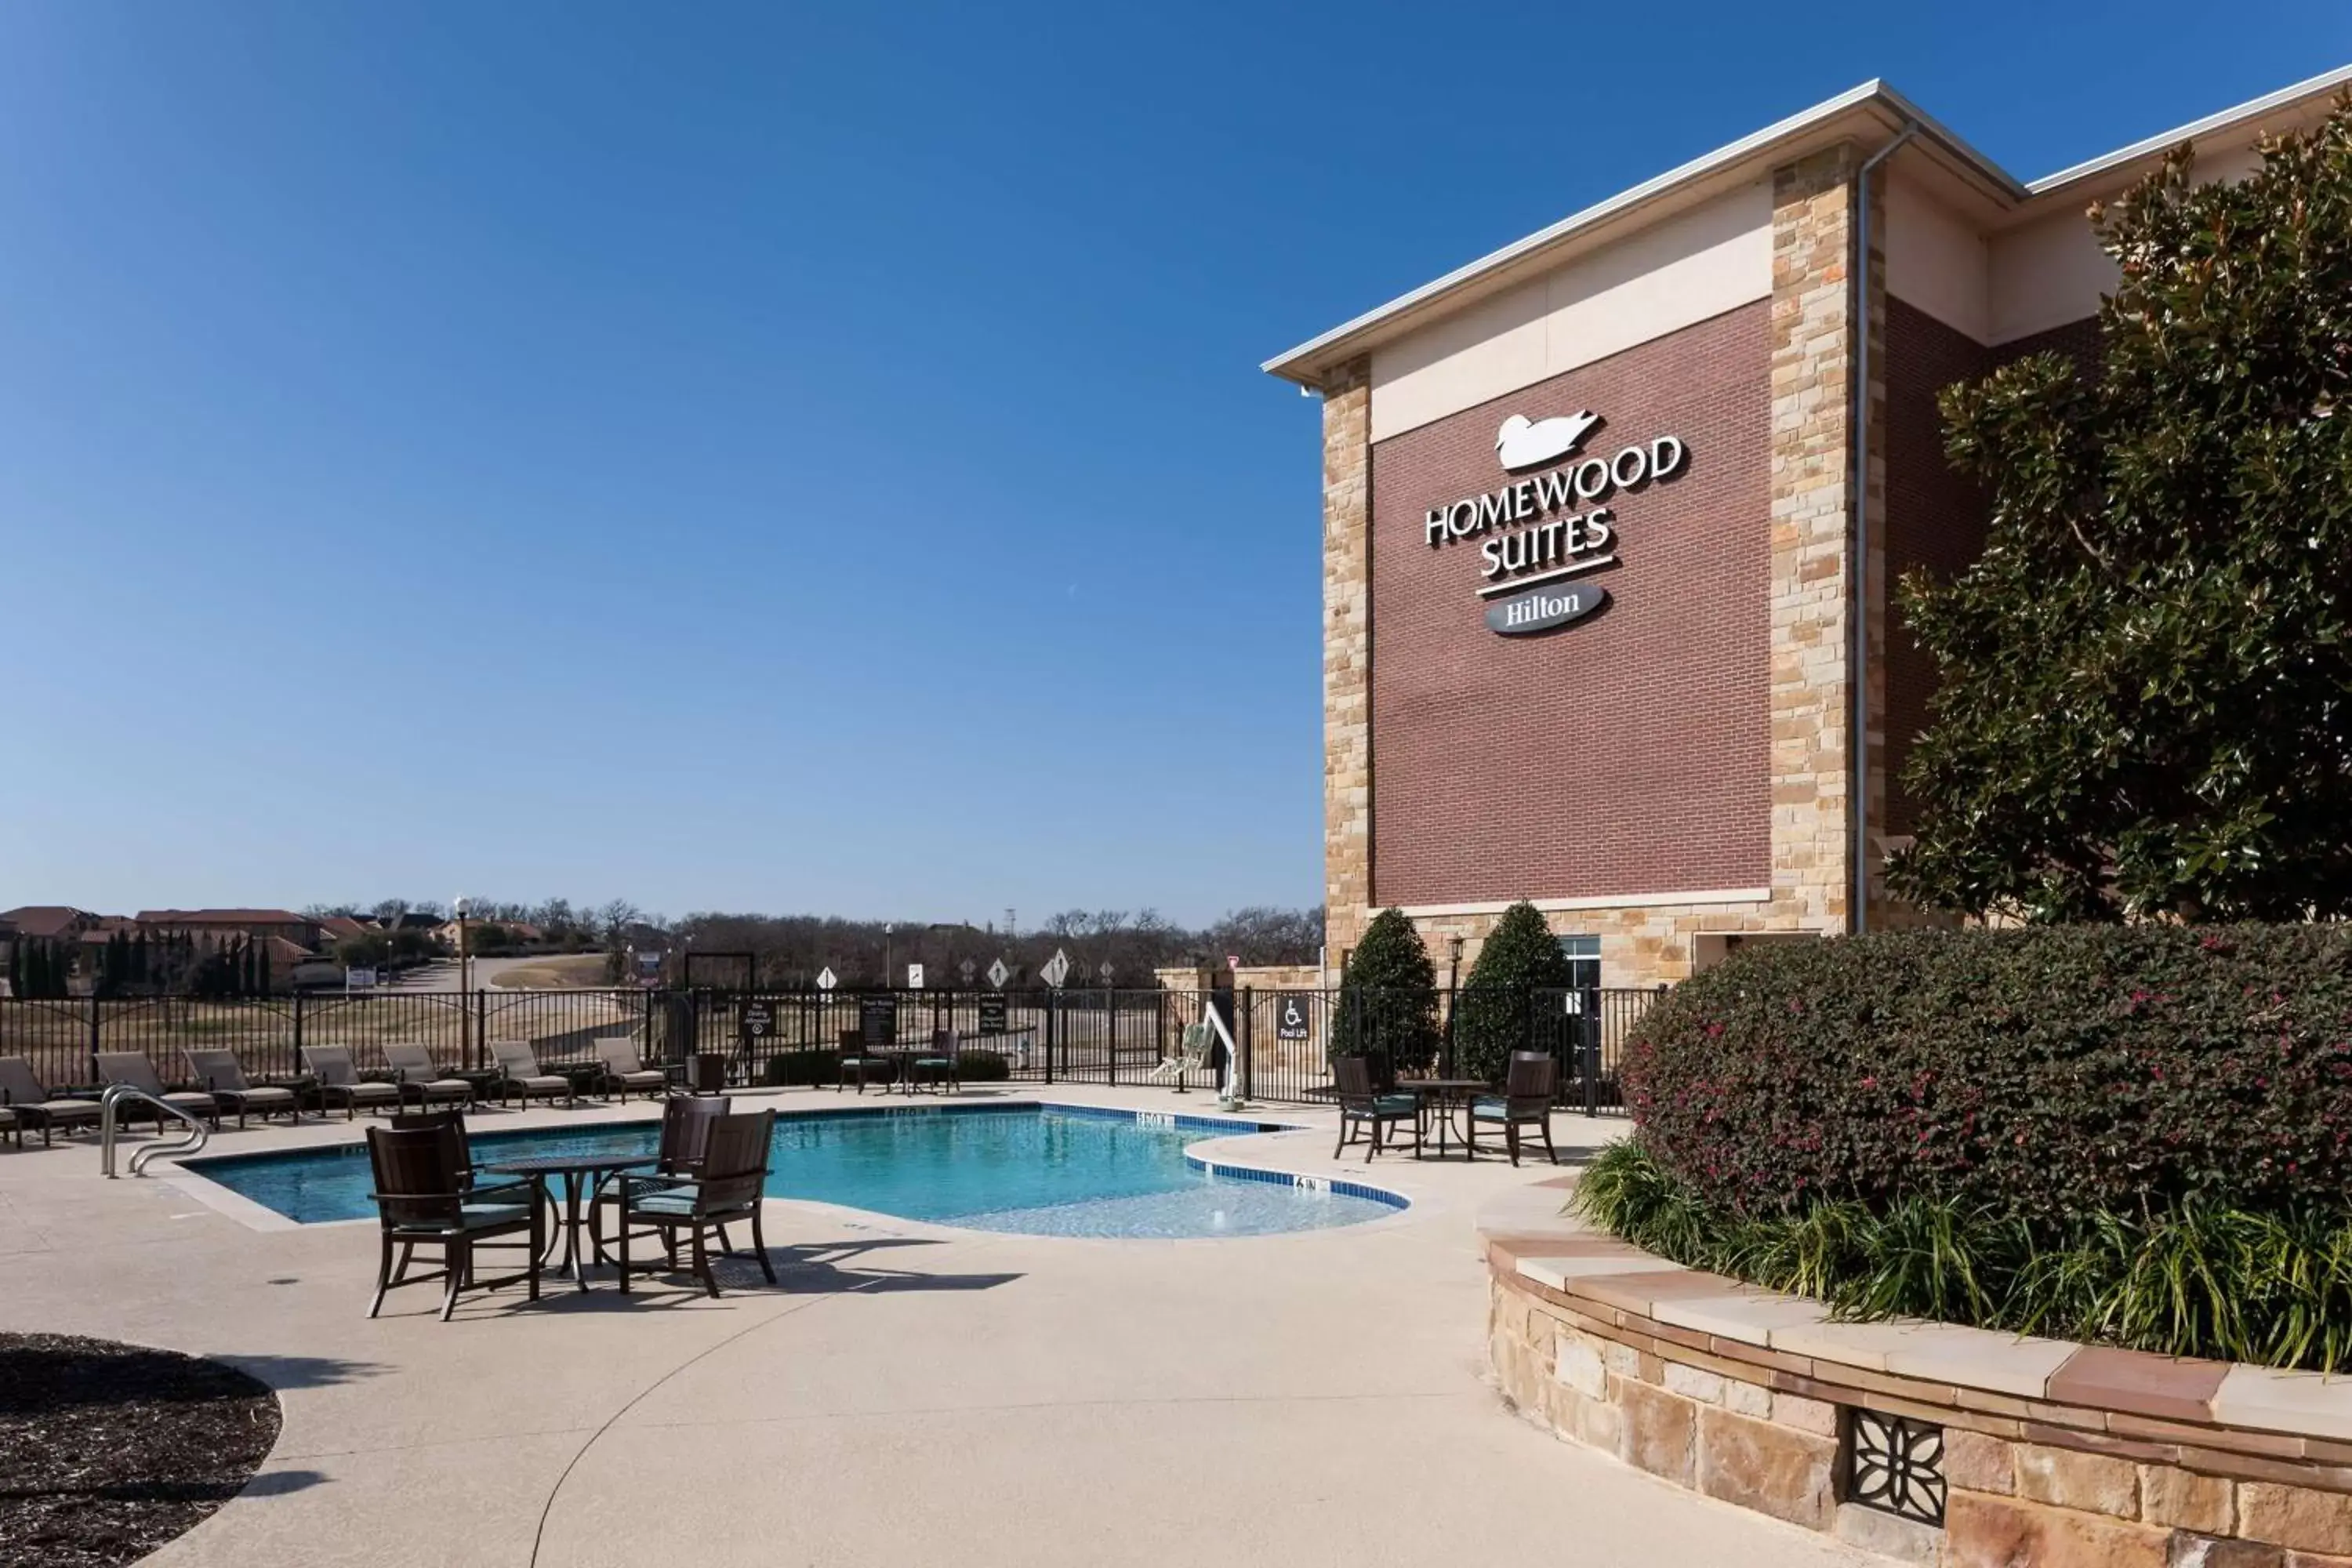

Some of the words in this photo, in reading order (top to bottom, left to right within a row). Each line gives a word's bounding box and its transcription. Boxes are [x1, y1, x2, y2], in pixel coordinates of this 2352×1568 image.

[1425, 435, 1682, 545] HOMEWOOD
[1480, 507, 1610, 578] SUITES
[1505, 593, 1580, 626] Hilton
[1279, 1028, 1294, 1037] Pool
[1296, 1028, 1308, 1037] Lift
[1296, 1176, 1304, 1189] 6
